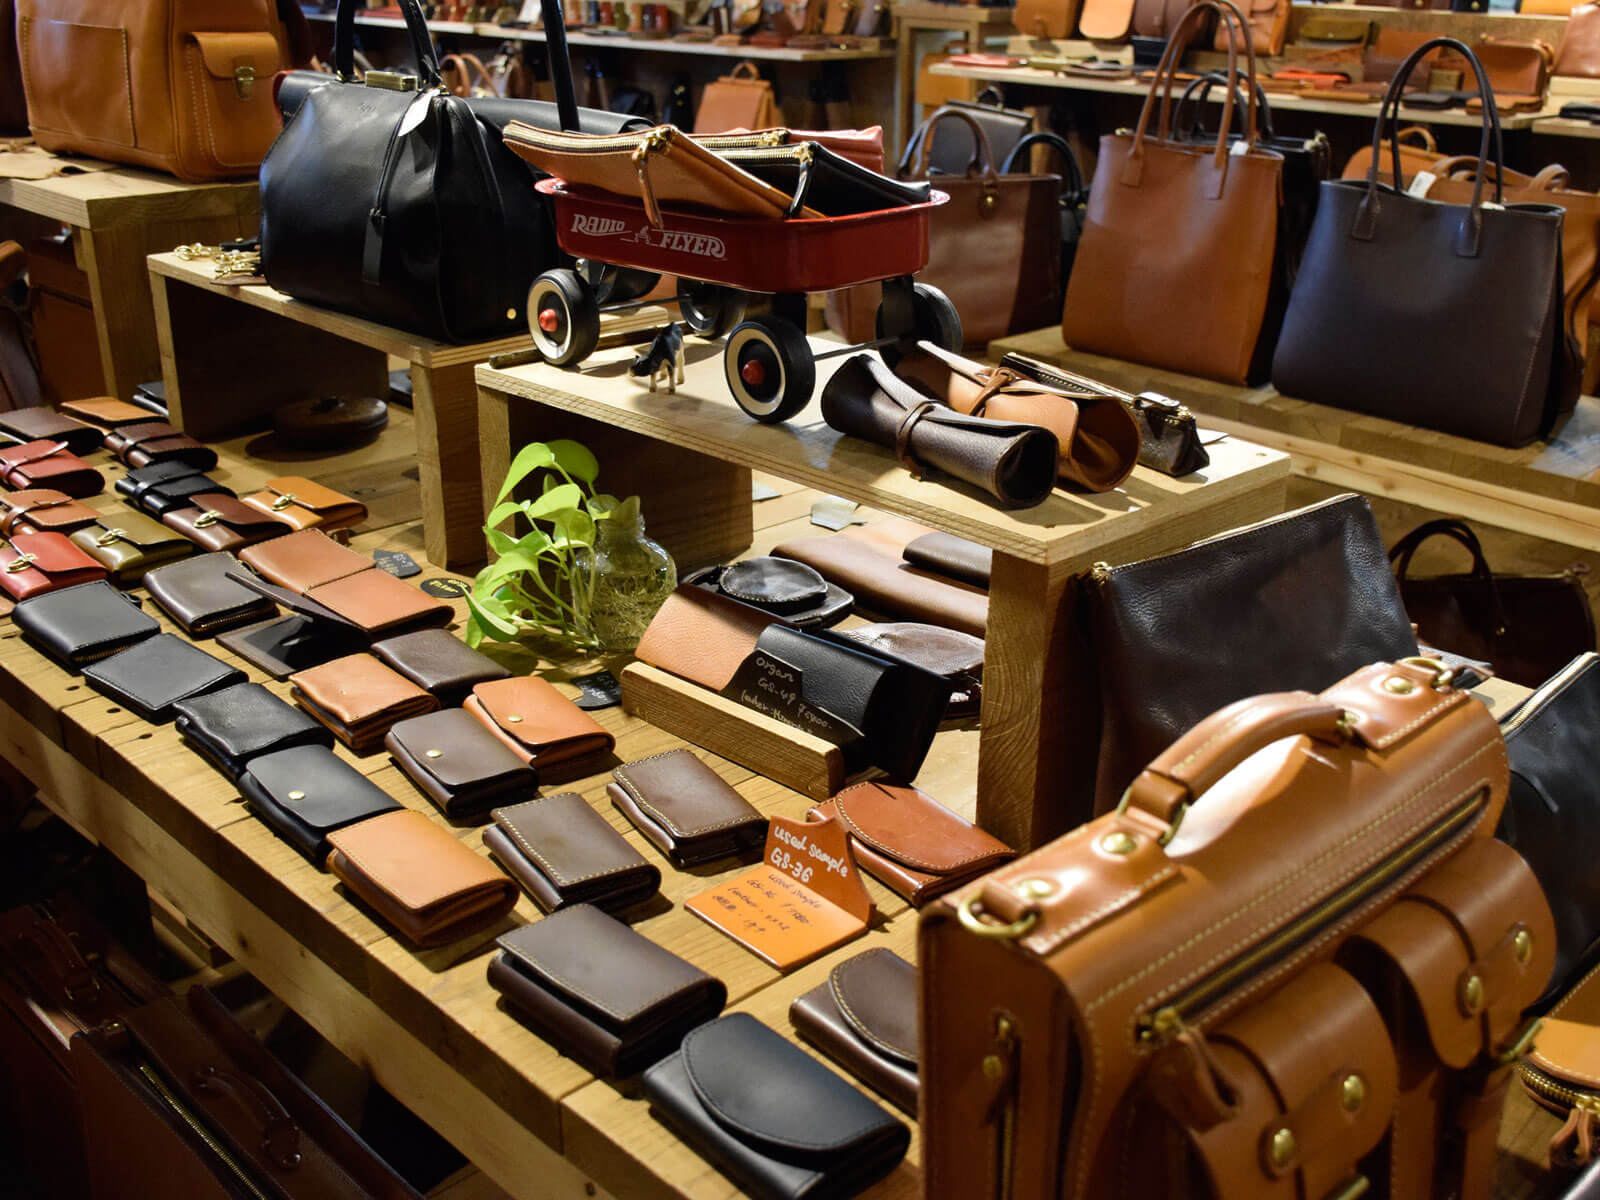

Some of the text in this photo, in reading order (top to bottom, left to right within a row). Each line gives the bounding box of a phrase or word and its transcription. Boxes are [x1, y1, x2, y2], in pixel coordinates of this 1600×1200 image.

[570, 213, 726, 259] RADIO FLYER
[770, 847, 814, 883] GS-36
[774, 826, 848, 878] used sample
